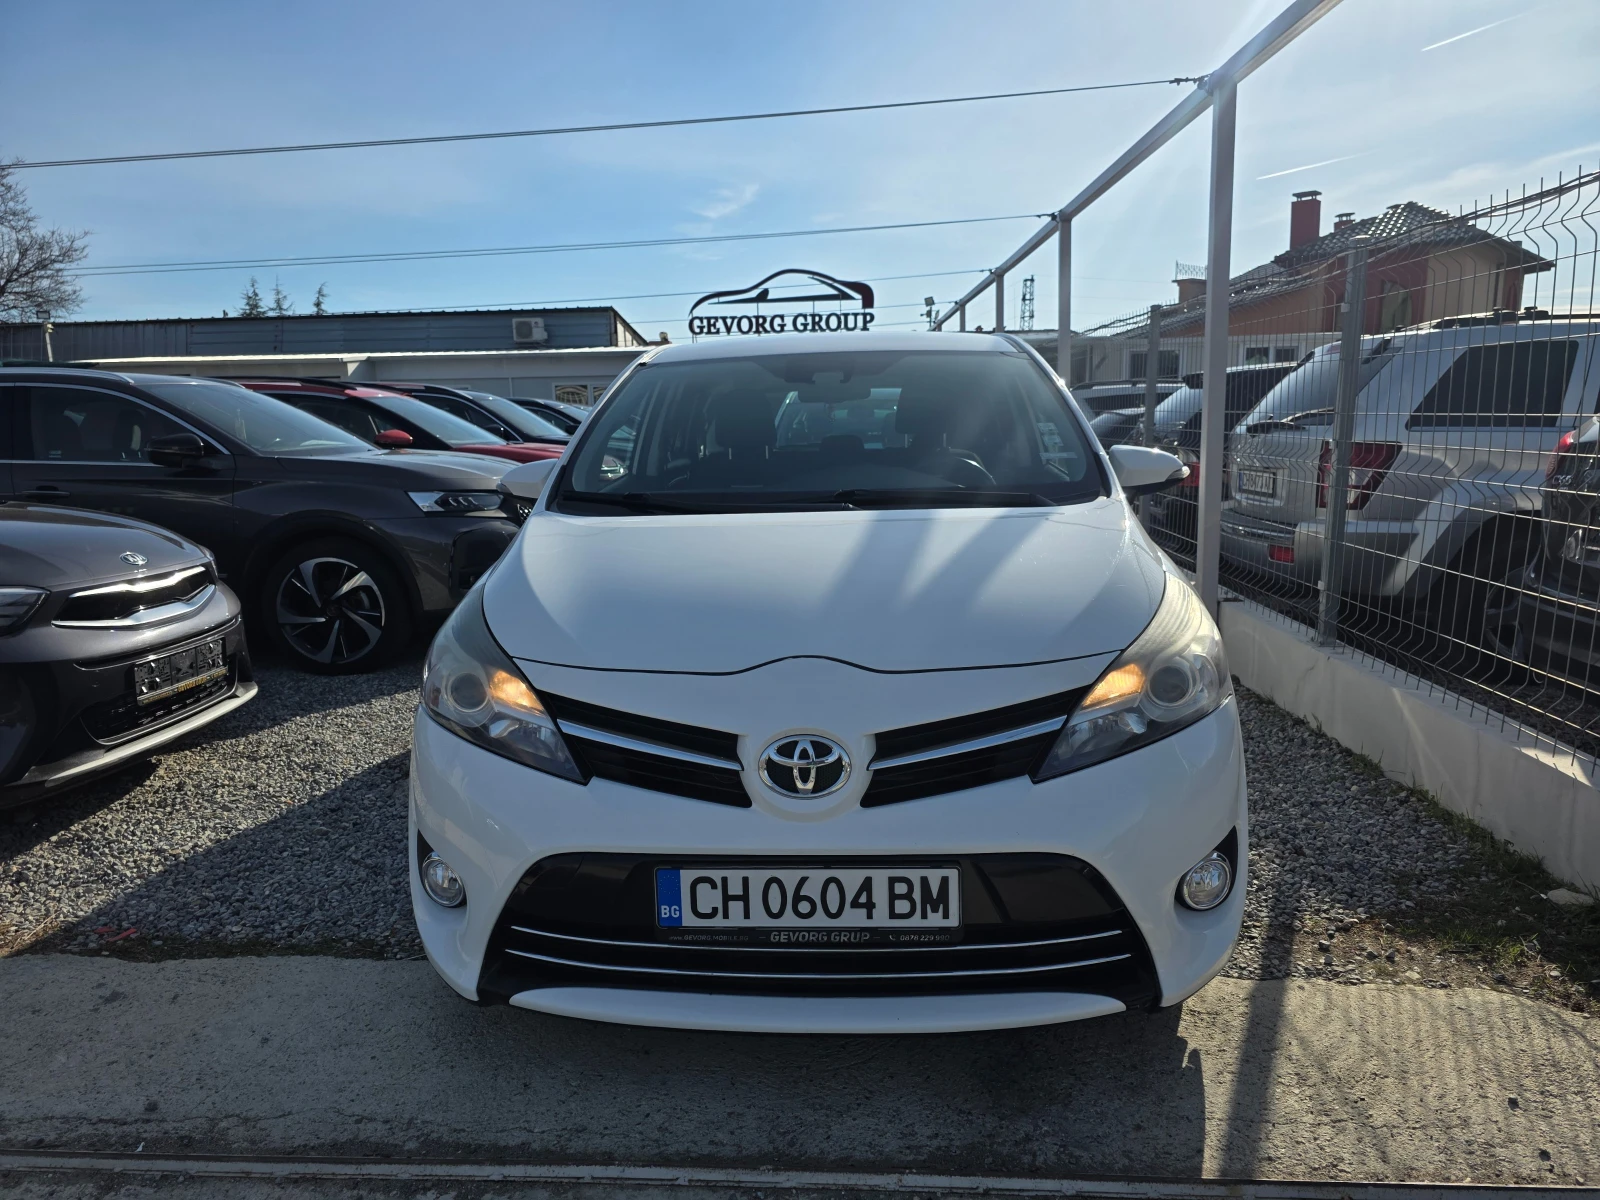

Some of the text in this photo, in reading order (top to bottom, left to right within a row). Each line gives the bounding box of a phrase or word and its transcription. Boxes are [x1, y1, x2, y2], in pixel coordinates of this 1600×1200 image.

[688, 313, 875, 335] GEVORG GROUP
[661, 905, 680, 918] BG
[770, 931, 870, 943] GEVORG GRUP
